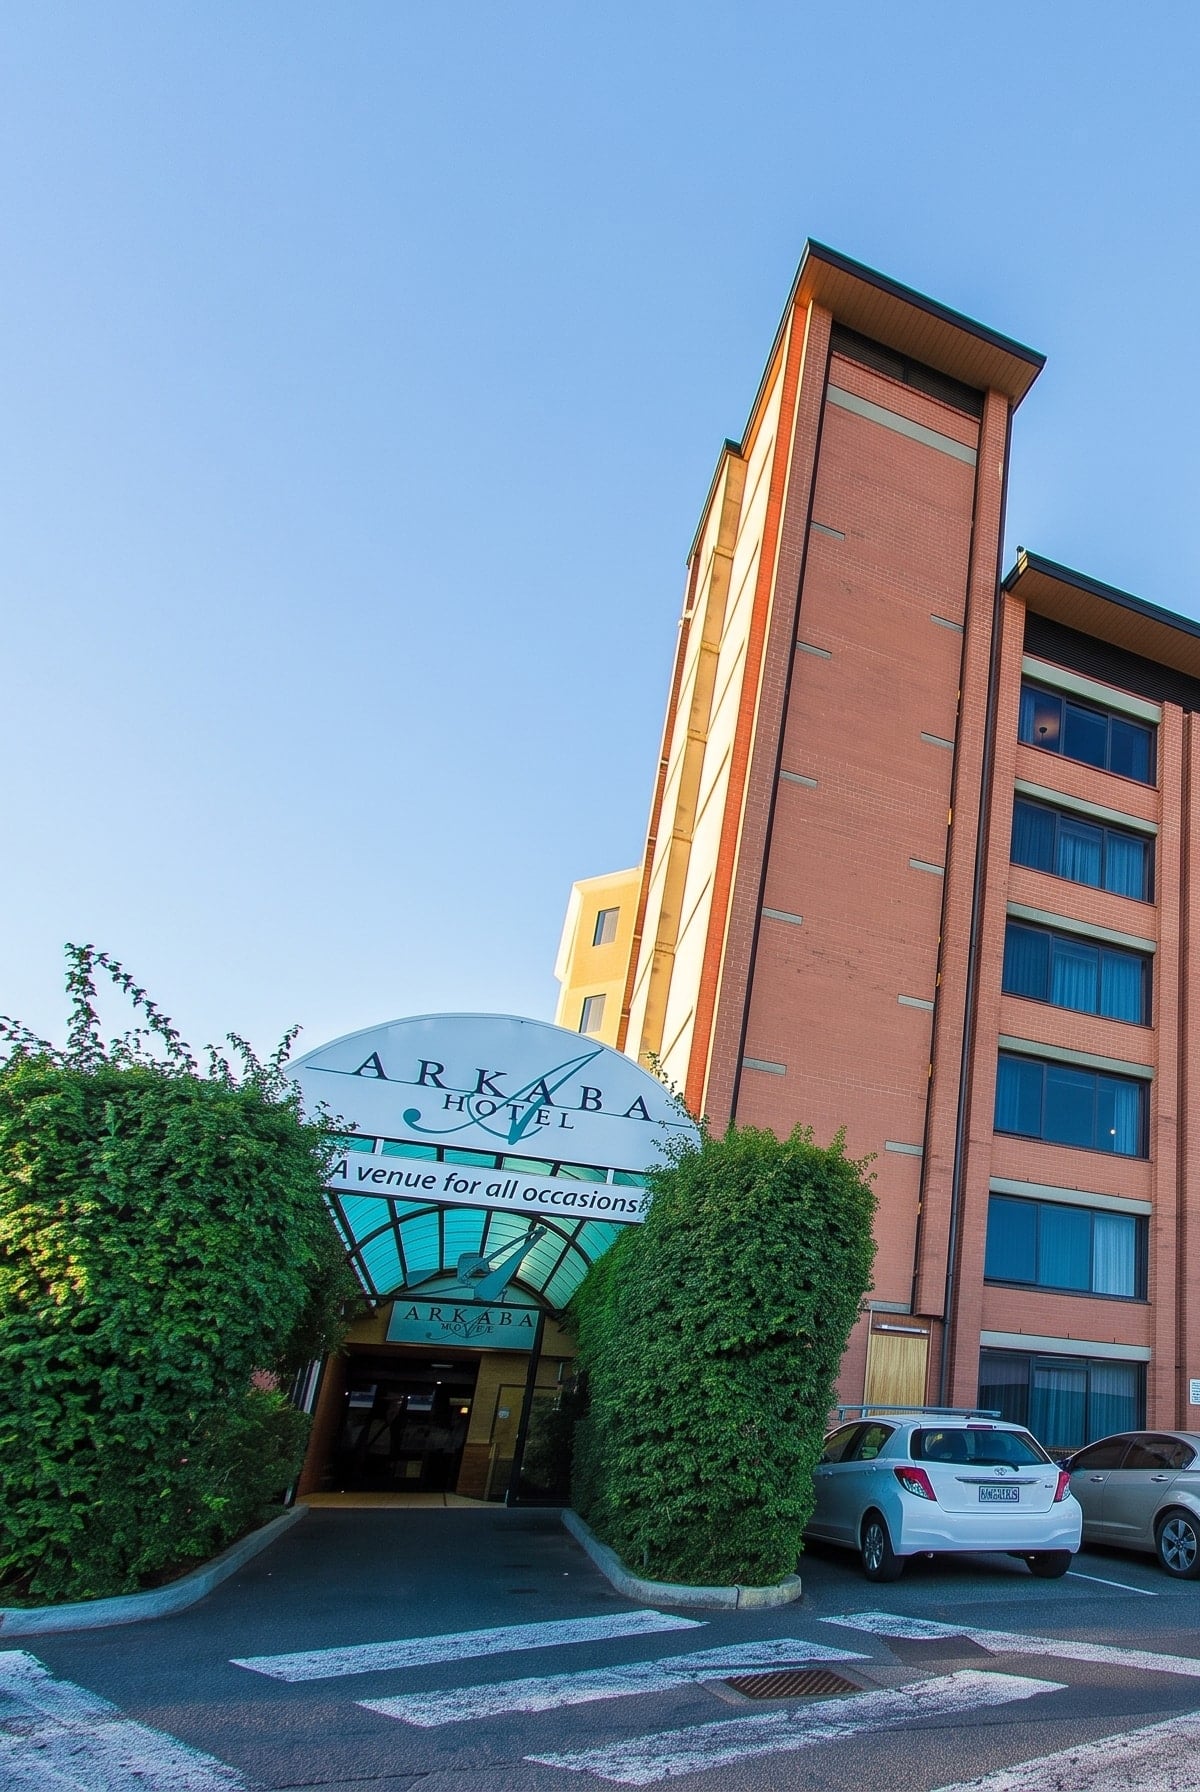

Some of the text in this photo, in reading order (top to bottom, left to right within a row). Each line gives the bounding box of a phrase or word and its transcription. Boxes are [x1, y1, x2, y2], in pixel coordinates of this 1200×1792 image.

[350, 1051, 652, 1121] ARKABA
[442, 1093, 575, 1129] HOTEL
[332, 1159, 348, 1179] A
[357, 1166, 436, 1189] venue
[443, 1172, 482, 1194] for
[485, 1179, 519, 1199] all
[403, 1305, 534, 1327] ARKABA
